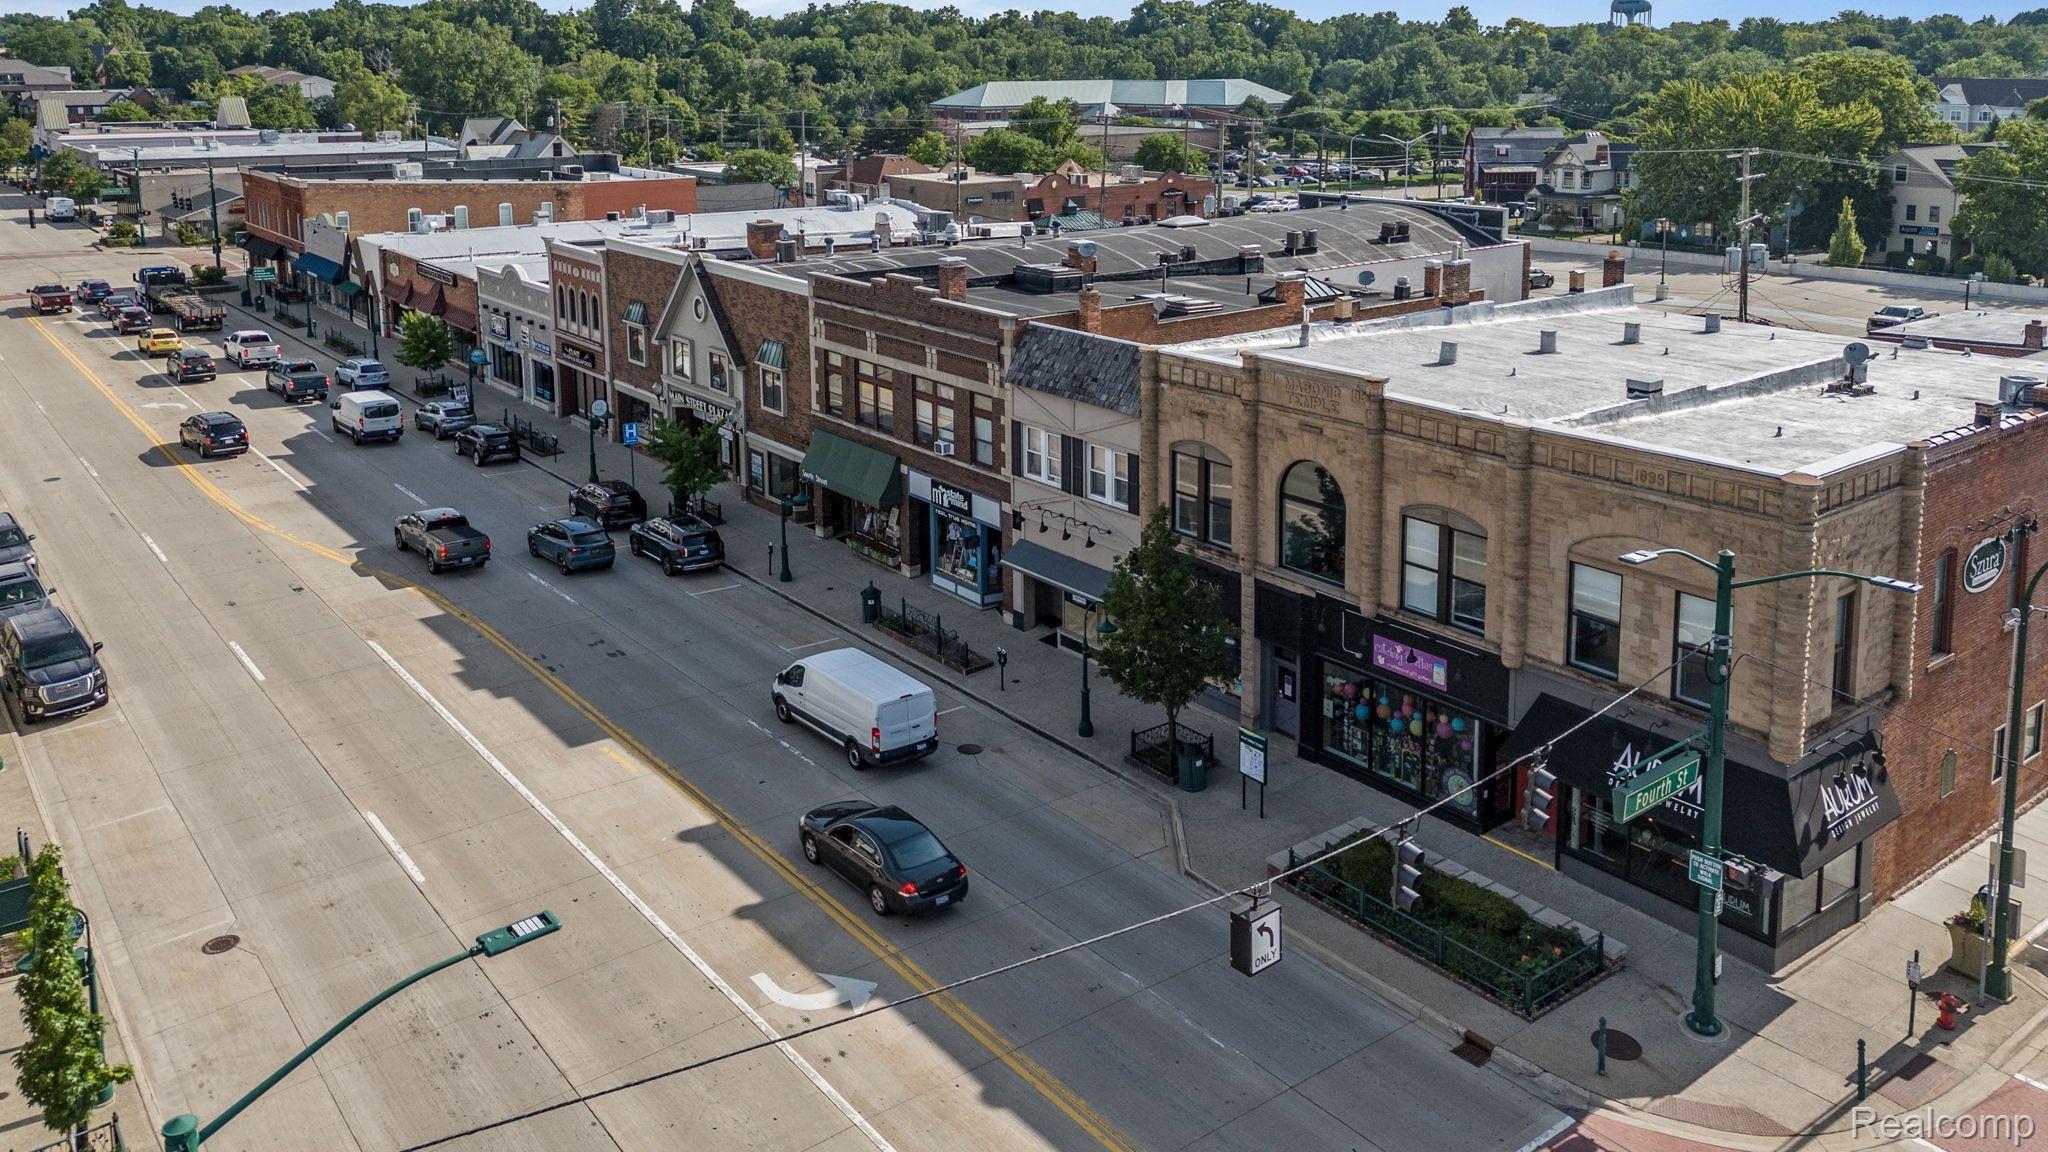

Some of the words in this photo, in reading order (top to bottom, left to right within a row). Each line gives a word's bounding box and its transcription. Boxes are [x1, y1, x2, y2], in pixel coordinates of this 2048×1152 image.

[1285, 377, 1341, 399] MASONIC
[669, 390, 685, 405] MAIN
[686, 396, 707, 413] STREET
[1287, 391, 1340, 416] TEMPLE
[625, 423, 637, 438] H
[1635, 469, 1664, 487] 1899
[1970, 553, 1999, 579] Szura
[1635, 776, 1672, 811] Fourth
[1676, 767, 1689, 789] St
[1820, 773, 1875, 822] AURUM
[1831, 818, 1854, 839] DESIGN
[1853, 801, 1880, 826] JEWELRY
[1722, 892, 1750, 913] URUM
[1255, 949, 1277, 968] ONLY
